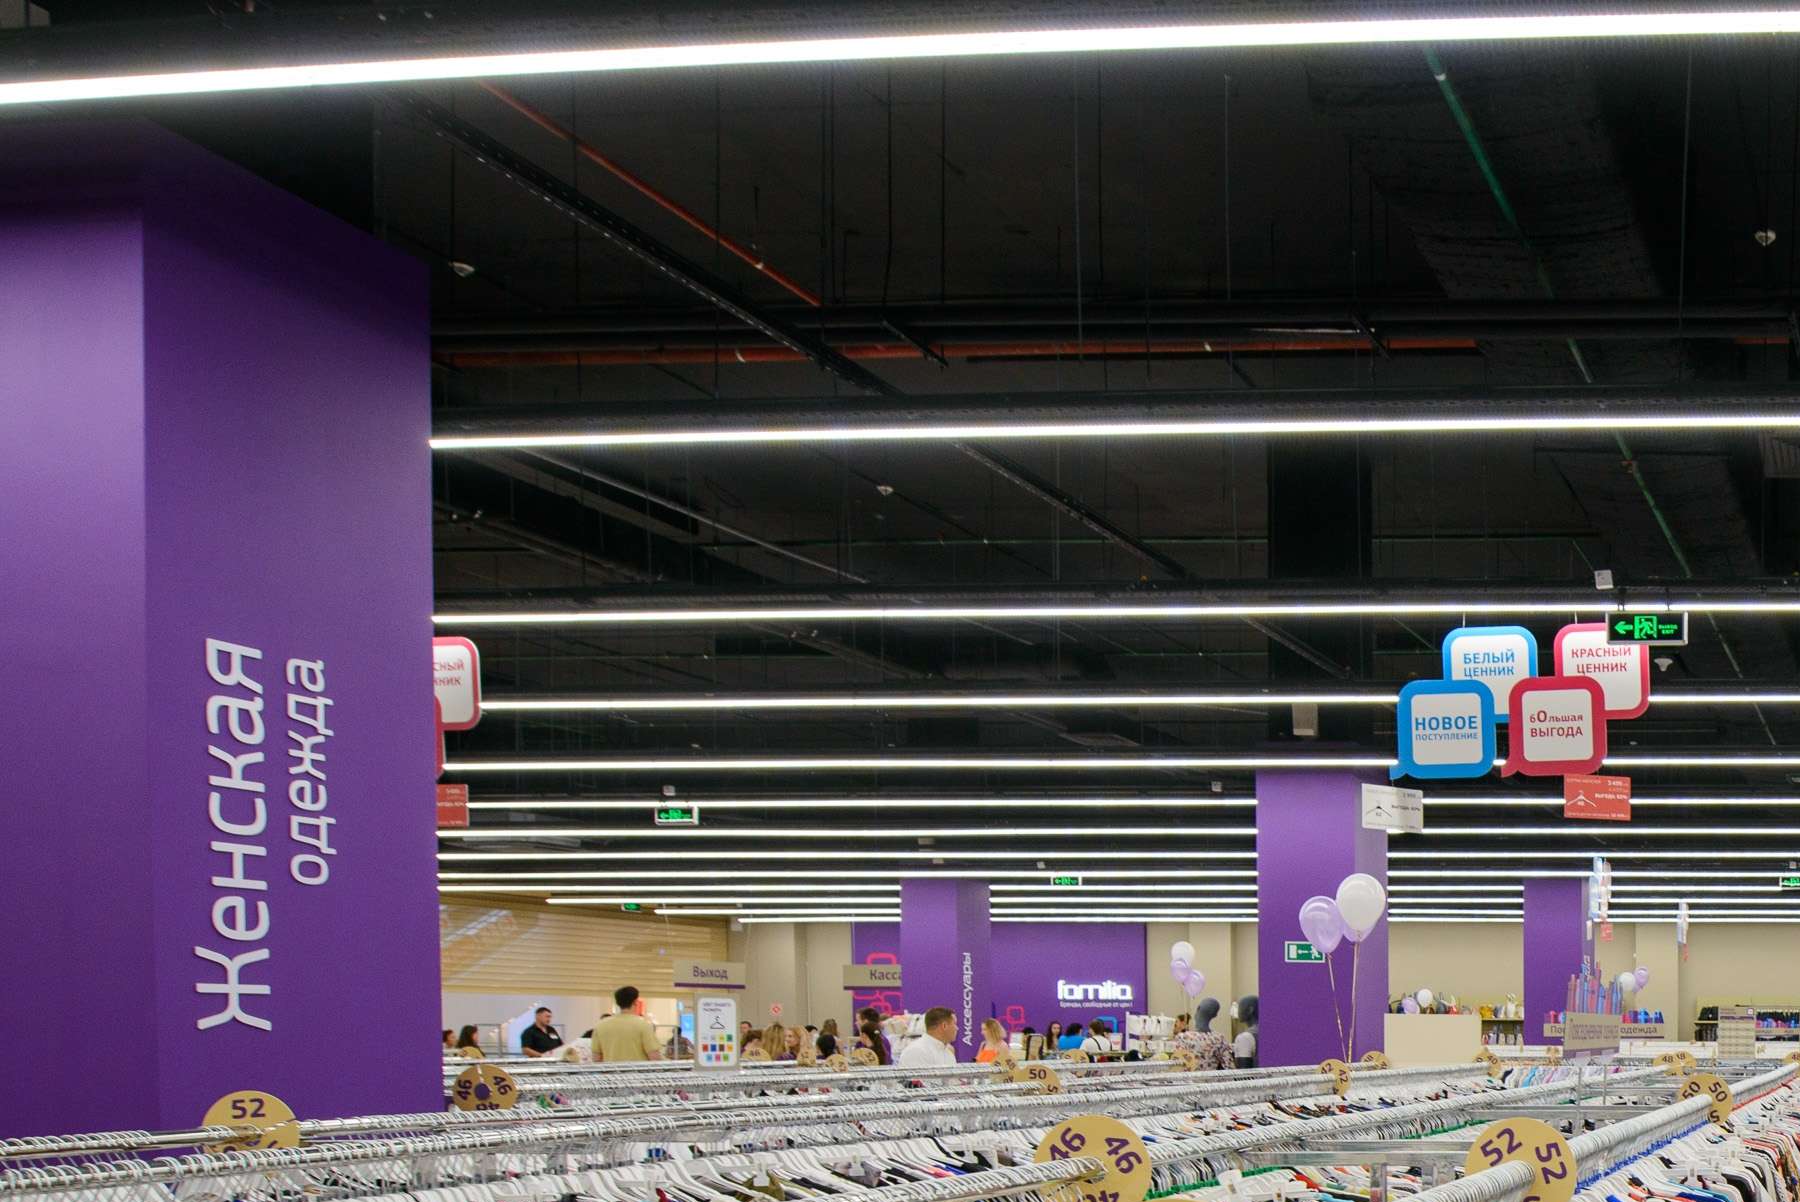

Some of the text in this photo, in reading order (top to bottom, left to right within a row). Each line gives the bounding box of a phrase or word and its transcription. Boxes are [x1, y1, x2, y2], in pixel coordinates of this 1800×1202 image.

[1463, 649, 1515, 665] БЕЛЫЙ
[1571, 646, 1631, 658] КРАСНЫЙ
[1464, 666, 1514, 677] ЦЕННИК
[1576, 662, 1627, 674] ЦЕННИК
[1415, 715, 1478, 731] НОВОЕ
[1530, 726, 1584, 738] ВЫГОДА
[1415, 732, 1478, 741] ПОСТУПЛЕНИЕ
[285, 658, 337, 886] одежда
[194, 638, 273, 1032] Женская
[693, 966, 728, 980] Выход
[962, 952, 973, 1046] Аксессуары
[1057, 979, 1133, 1000] familia
[1661, 1055, 1674, 1064] 48
[1028, 1068, 1046, 1080] 50
[494, 1075, 513, 1096] 46
[1682, 1081, 1701, 1100] 50
[1708, 1081, 1728, 1103] 50
[231, 1098, 266, 1119] 52
[1049, 1127, 1087, 1162] 46
[1480, 1127, 1523, 1167] 52
[1104, 1136, 1143, 1175] 46
[1535, 1142, 1568, 1185] 52
